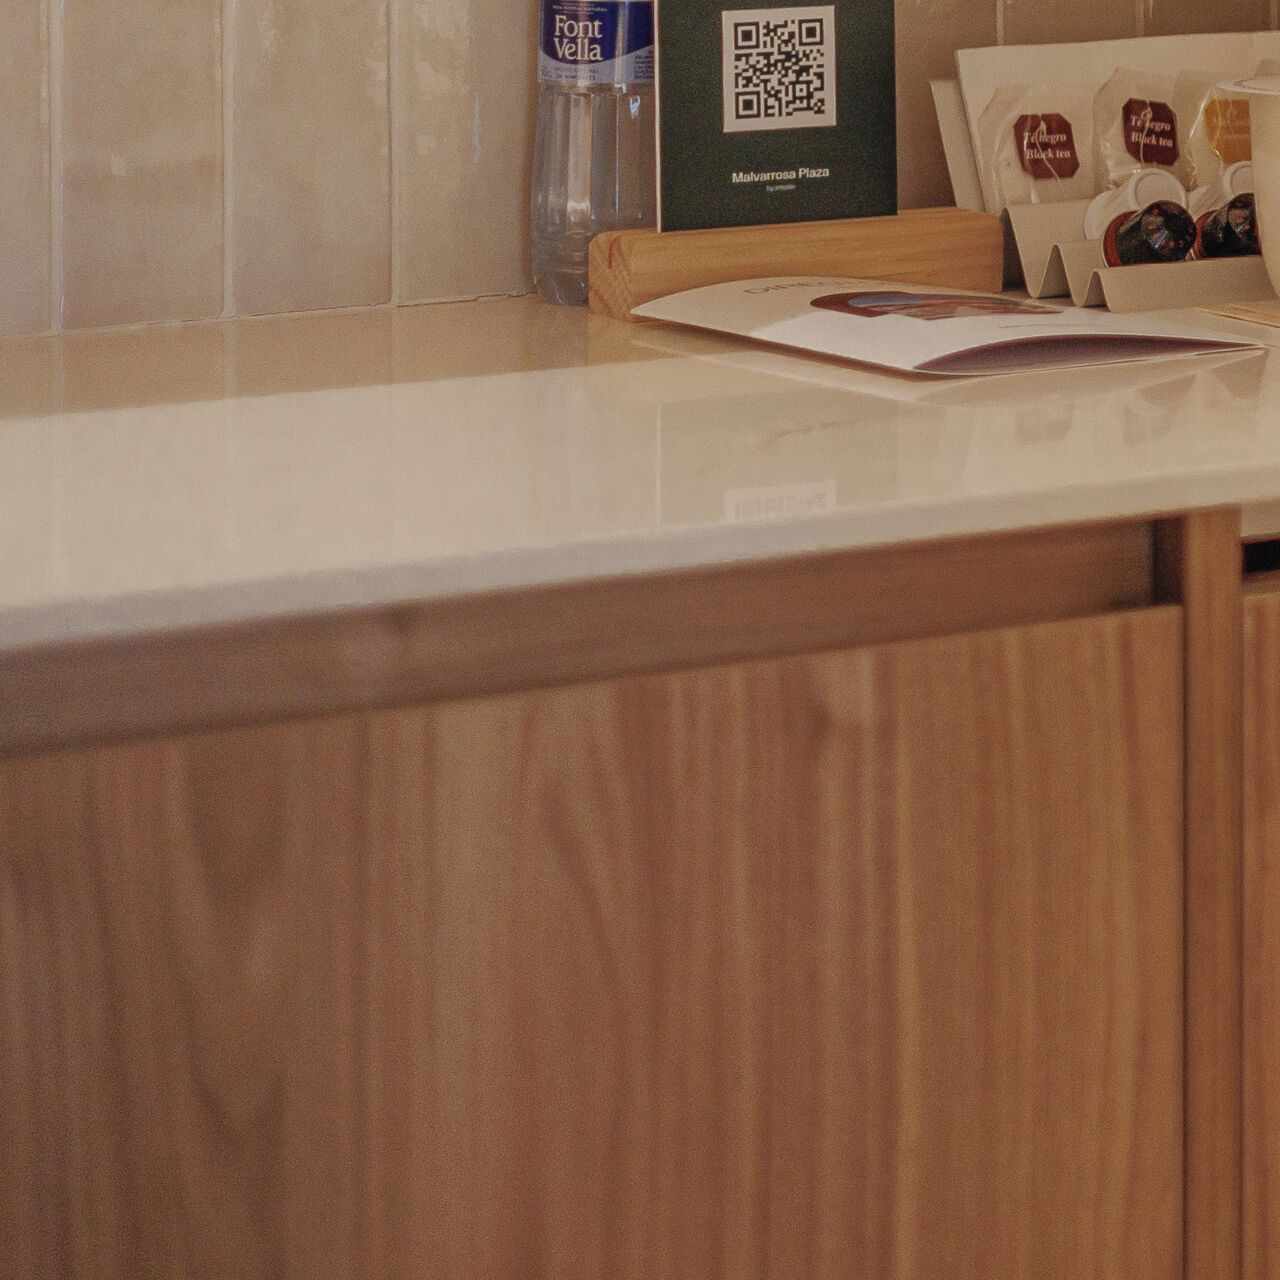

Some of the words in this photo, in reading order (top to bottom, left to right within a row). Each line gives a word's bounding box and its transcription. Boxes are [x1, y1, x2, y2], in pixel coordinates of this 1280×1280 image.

[553, 14, 603, 38] Font
[553, 37, 604, 61] Vella
[1158, 136, 1173, 148] tea
[1056, 149, 1071, 159] tea
[732, 171, 796, 183] Malvarrosa
[798, 167, 830, 179] Plaza
